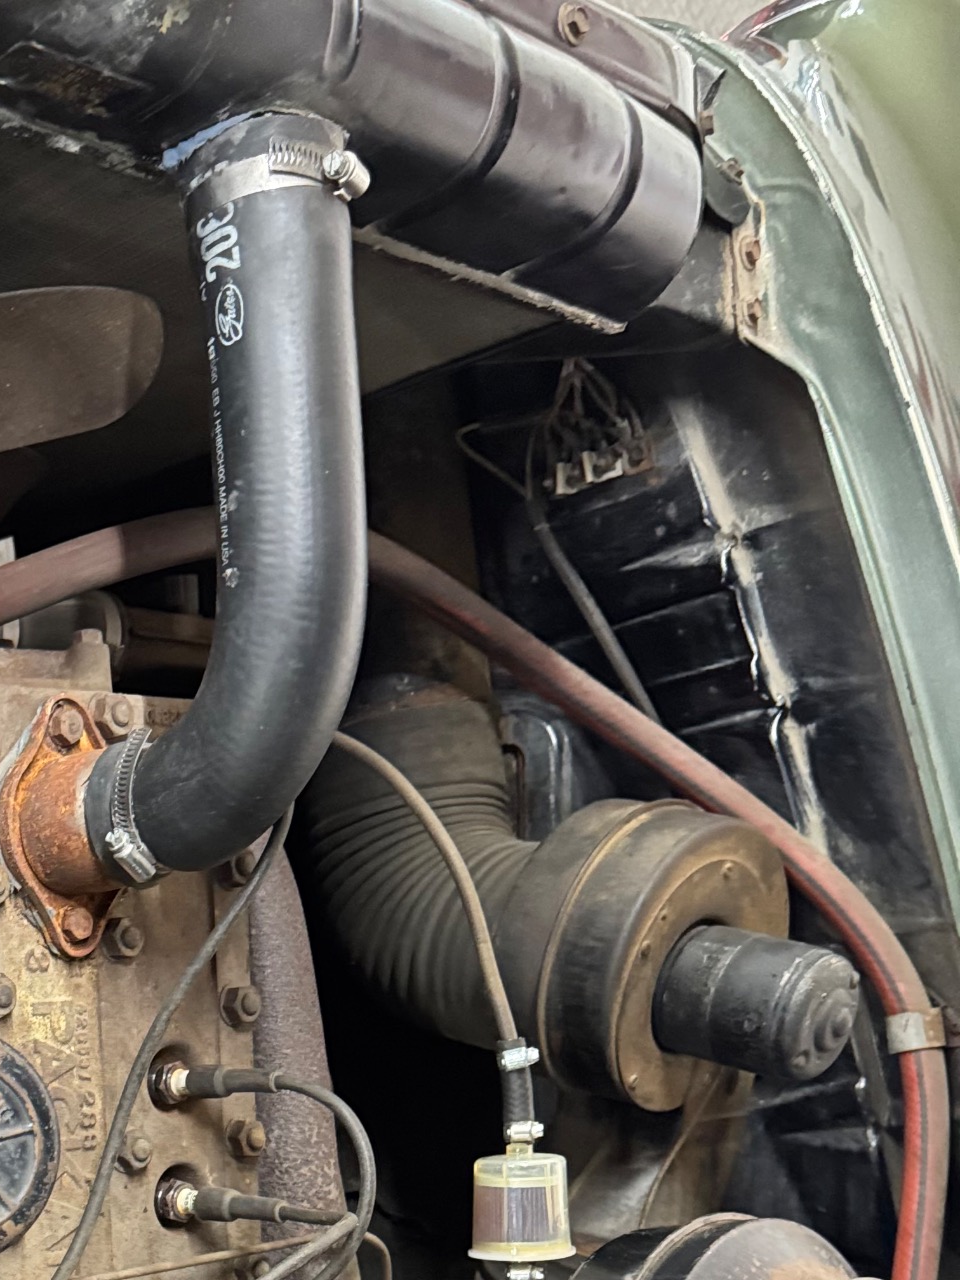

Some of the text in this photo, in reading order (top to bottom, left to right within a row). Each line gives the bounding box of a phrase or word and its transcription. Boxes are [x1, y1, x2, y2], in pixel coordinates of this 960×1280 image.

[216, 285, 243, 344] Gates
[218, 486, 228, 522] MADE
[220, 525, 229, 538] IN
[220, 541, 229, 566] USA
